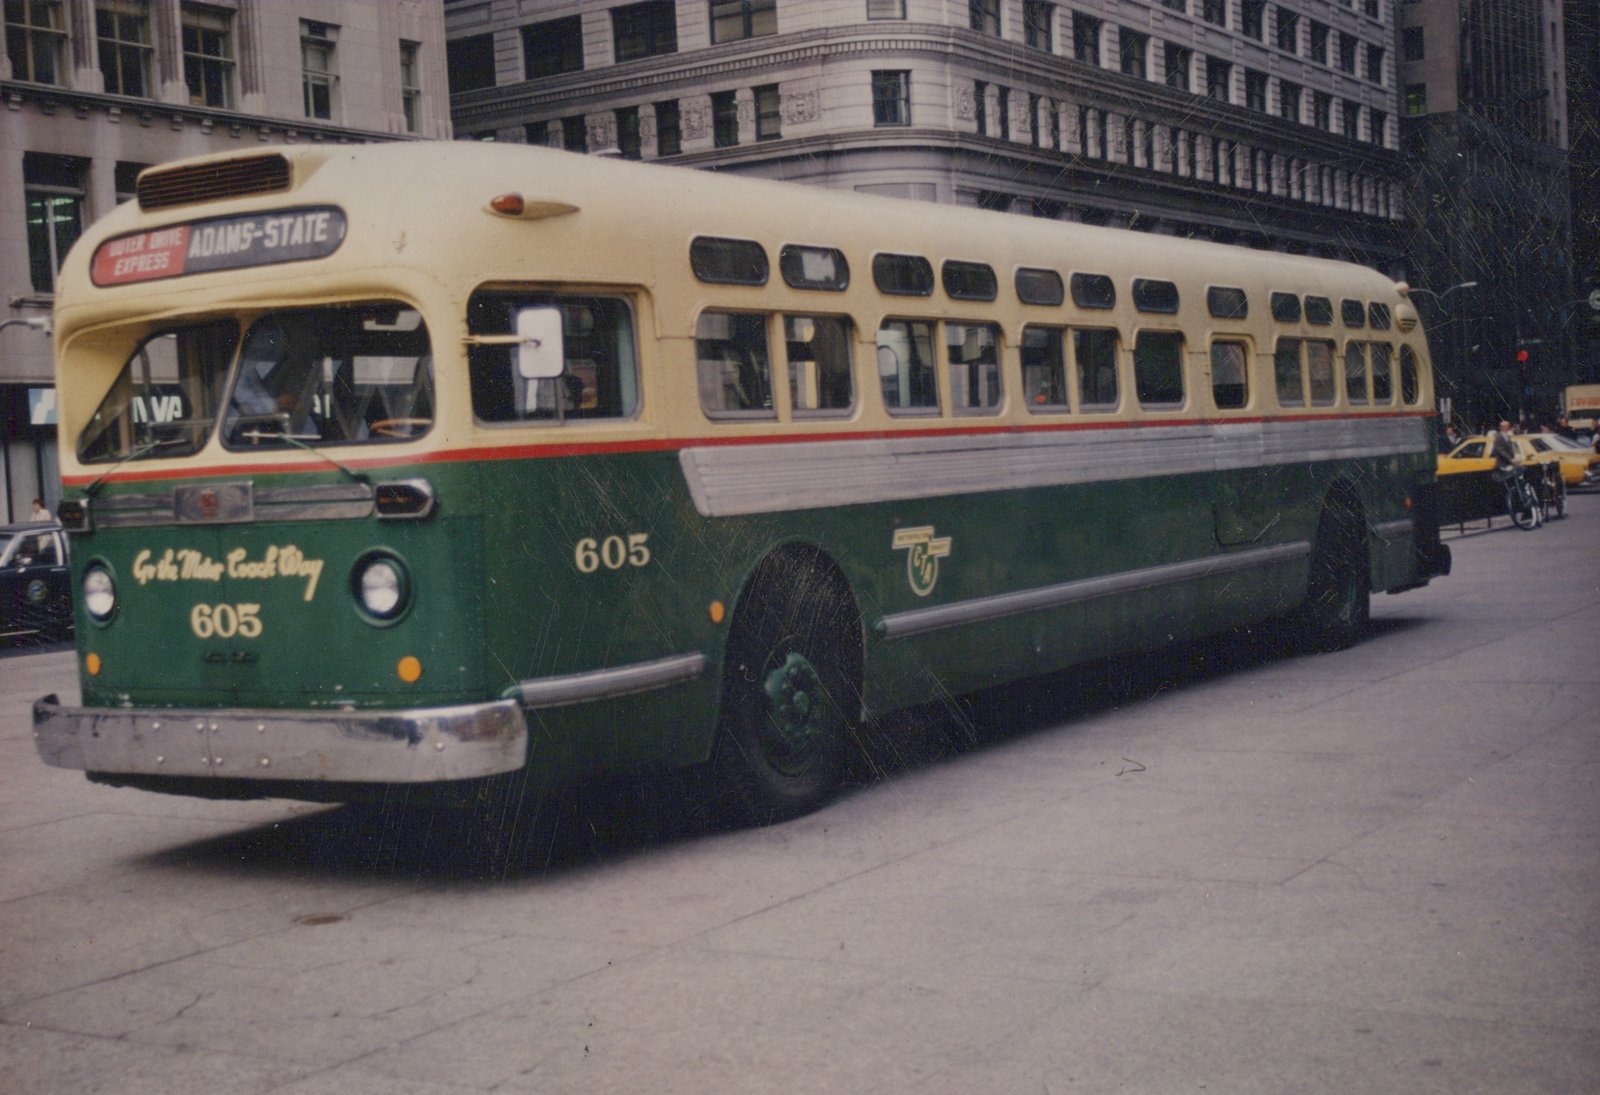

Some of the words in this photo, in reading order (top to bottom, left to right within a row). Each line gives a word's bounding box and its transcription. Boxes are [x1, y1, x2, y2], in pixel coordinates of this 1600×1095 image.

[189, 212, 331, 258] ADAMS-STATE
[113, 252, 170, 276] EXPRESS
[575, 532, 651, 573] 605
[191, 603, 263, 638] 605
